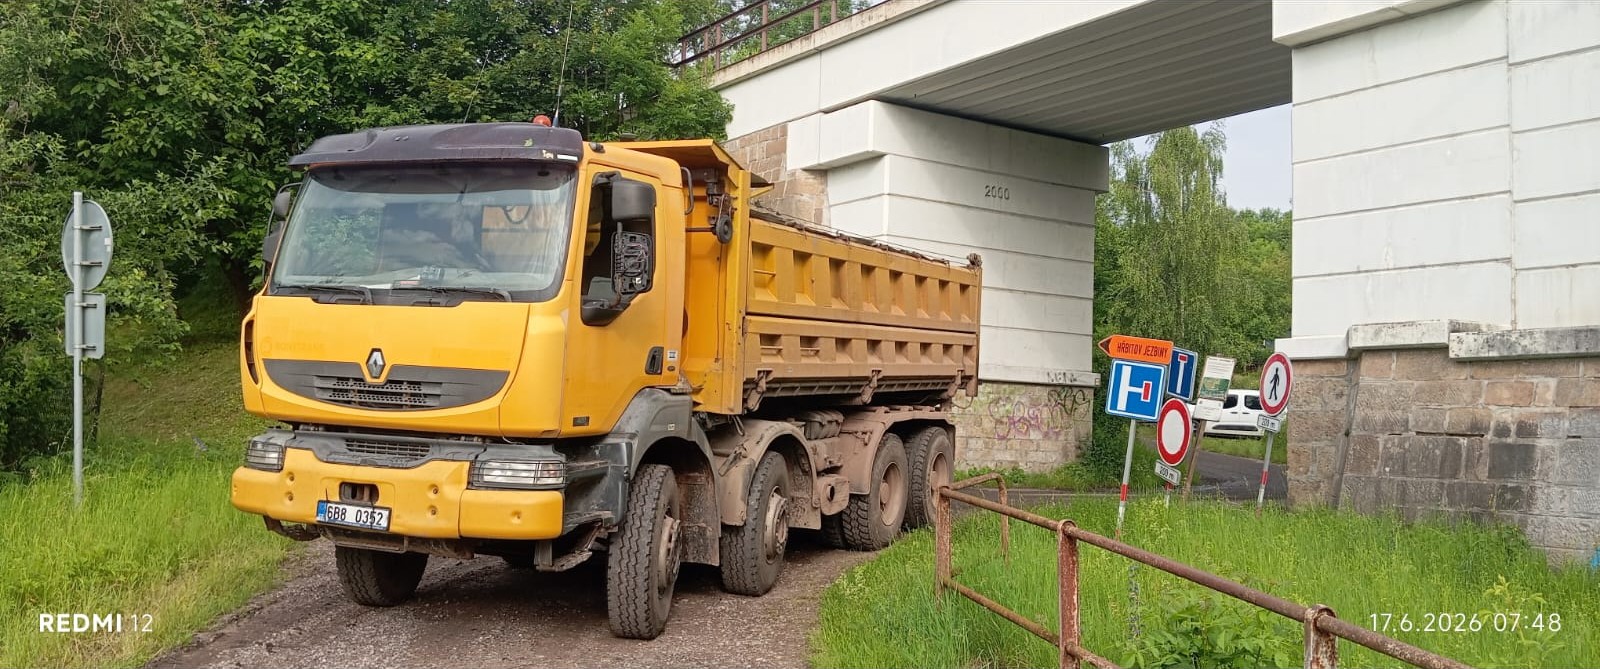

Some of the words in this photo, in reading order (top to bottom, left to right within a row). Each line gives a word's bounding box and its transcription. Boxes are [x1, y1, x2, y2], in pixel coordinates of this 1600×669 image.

[984, 184, 1010, 200] 2000
[1117, 341, 1143, 355] HŘBITOV
[1143, 345, 1169, 359] JEZBINY
[1261, 417, 1270, 427] 200
[1159, 466, 1169, 477] 200
[327, 505, 348, 521] 6B8
[355, 509, 384, 526] 0352
